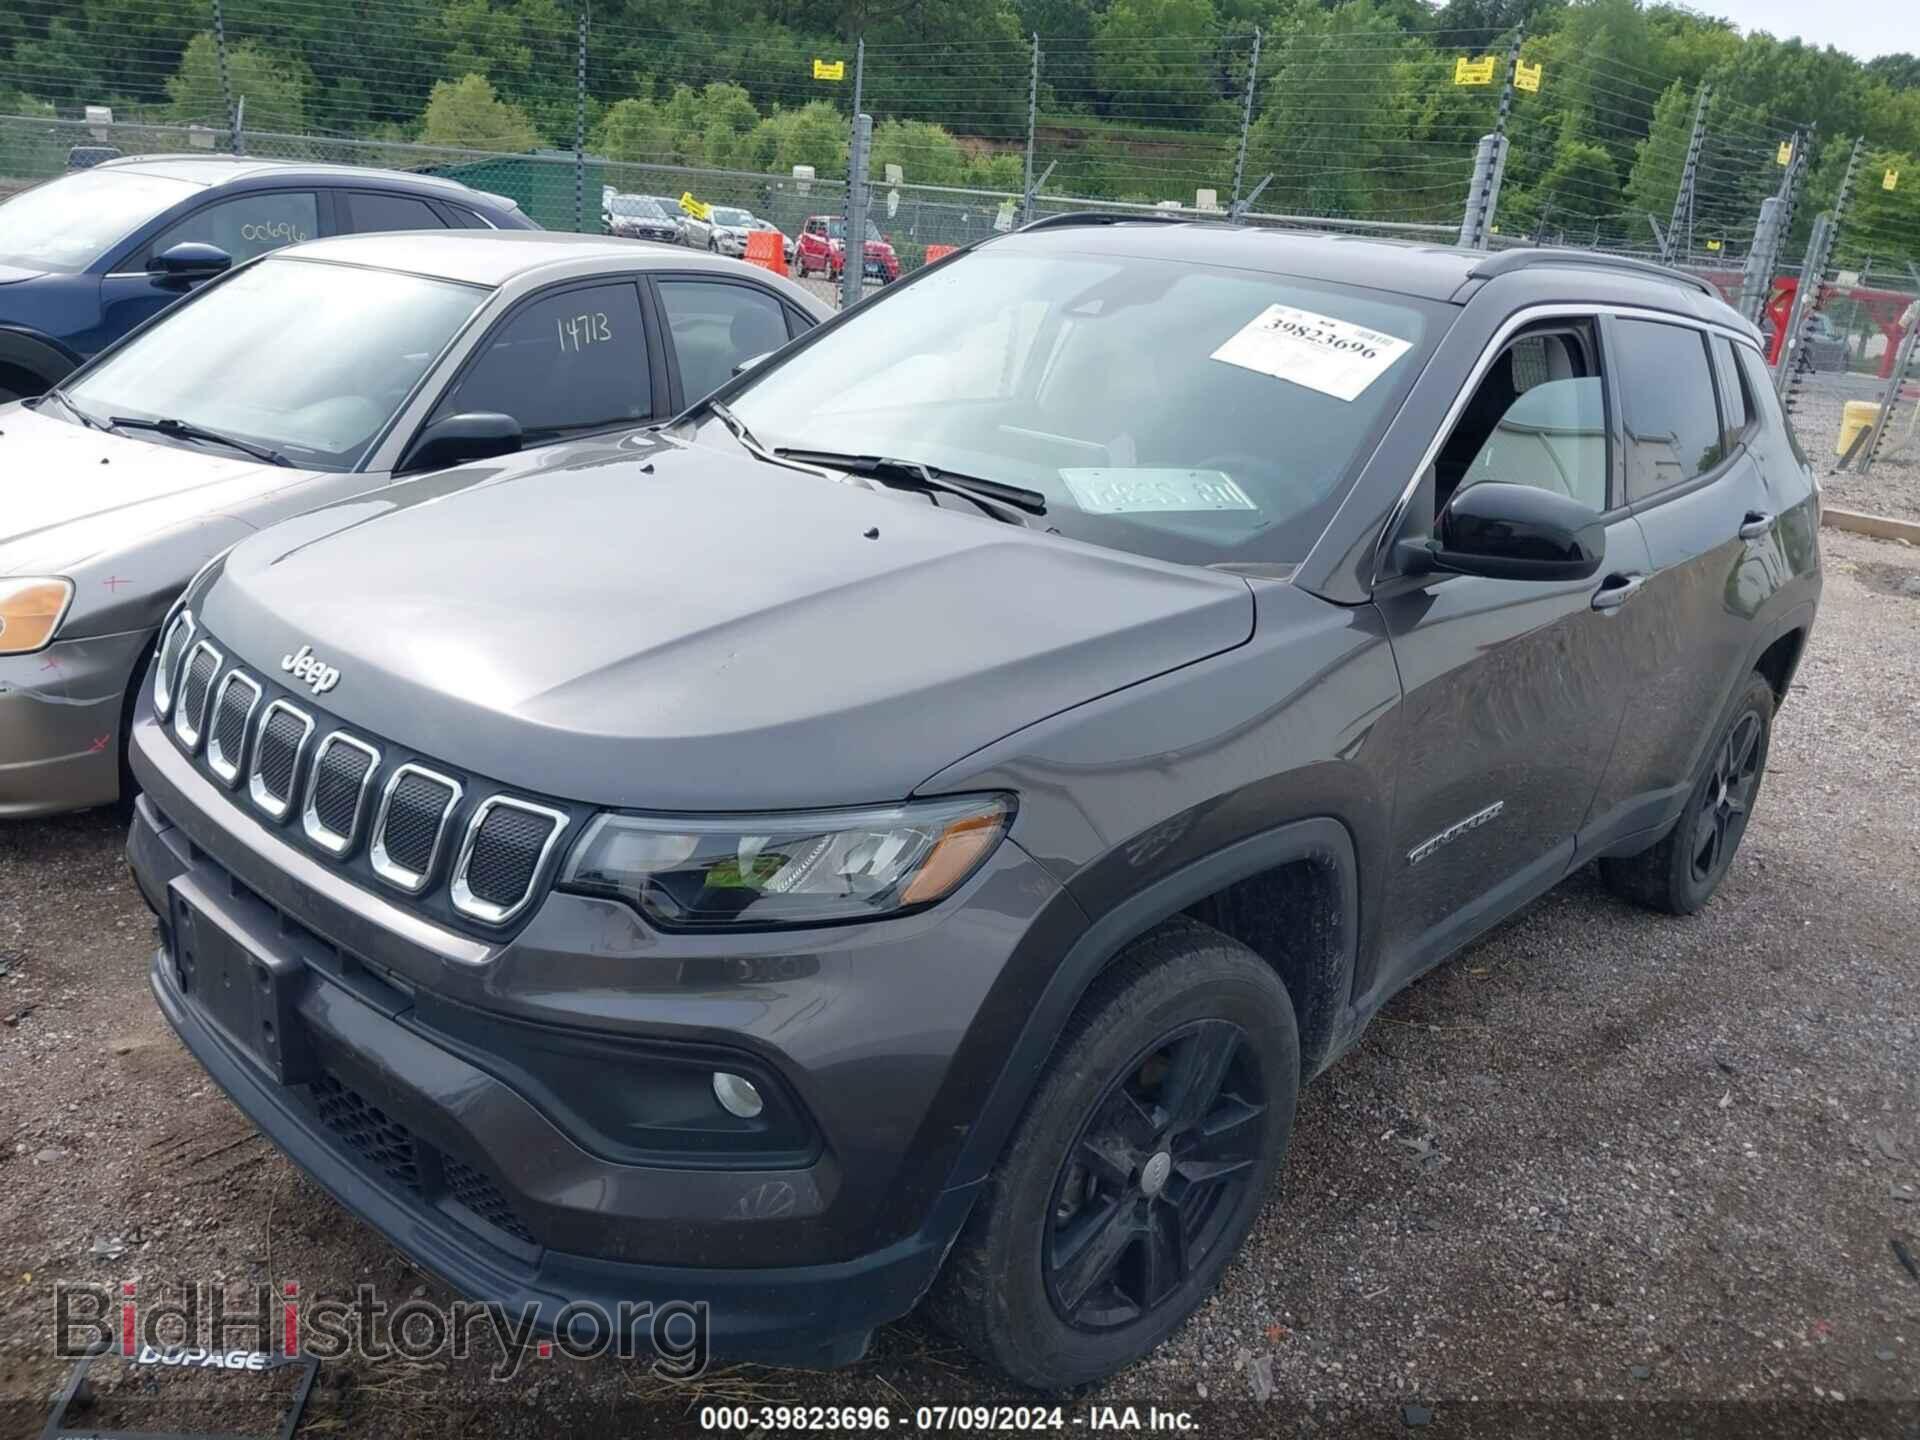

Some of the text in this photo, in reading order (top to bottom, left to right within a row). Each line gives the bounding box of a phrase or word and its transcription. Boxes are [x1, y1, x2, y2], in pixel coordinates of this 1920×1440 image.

[557, 312, 612, 352] 14713
[1265, 318, 1377, 360] 39823696
[281, 645, 340, 695] Jeep
[137, 1344, 267, 1371] DUPAGE
